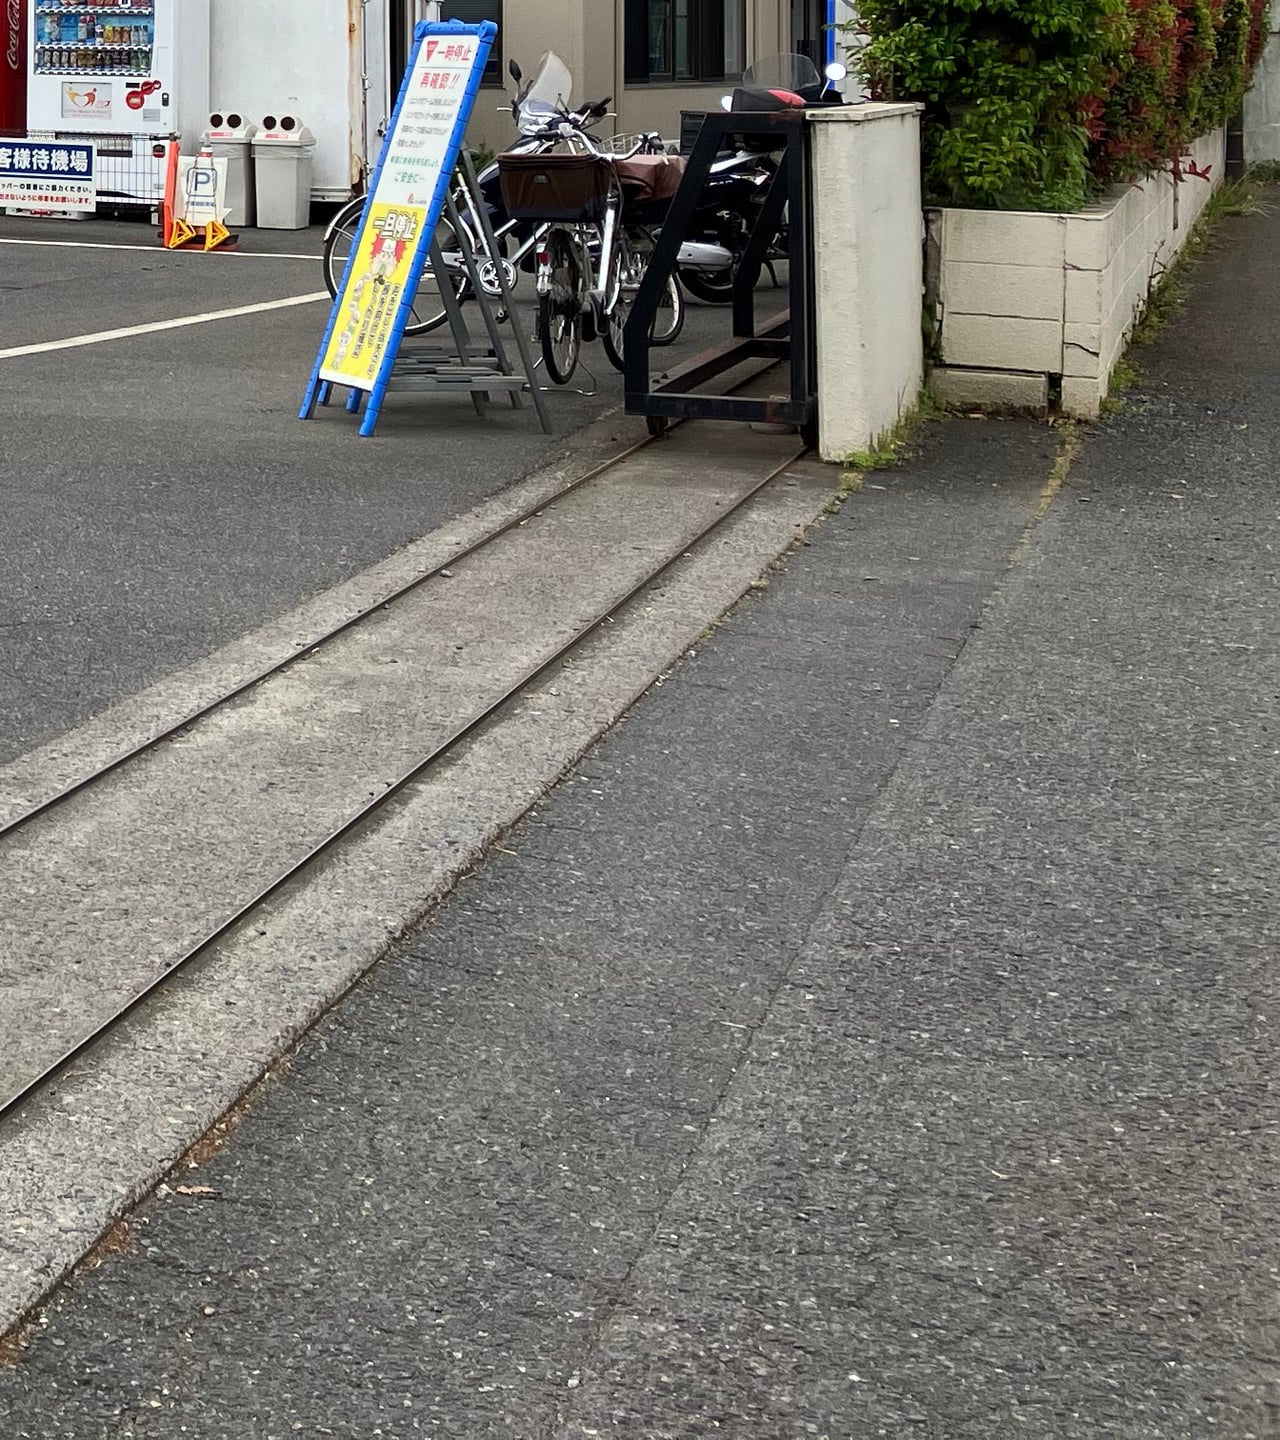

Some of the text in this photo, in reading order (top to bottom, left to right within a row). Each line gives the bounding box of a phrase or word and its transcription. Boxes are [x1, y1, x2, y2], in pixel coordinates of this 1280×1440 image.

[194, 172, 210, 191] P
[372, 211, 419, 241] 一旦停止
